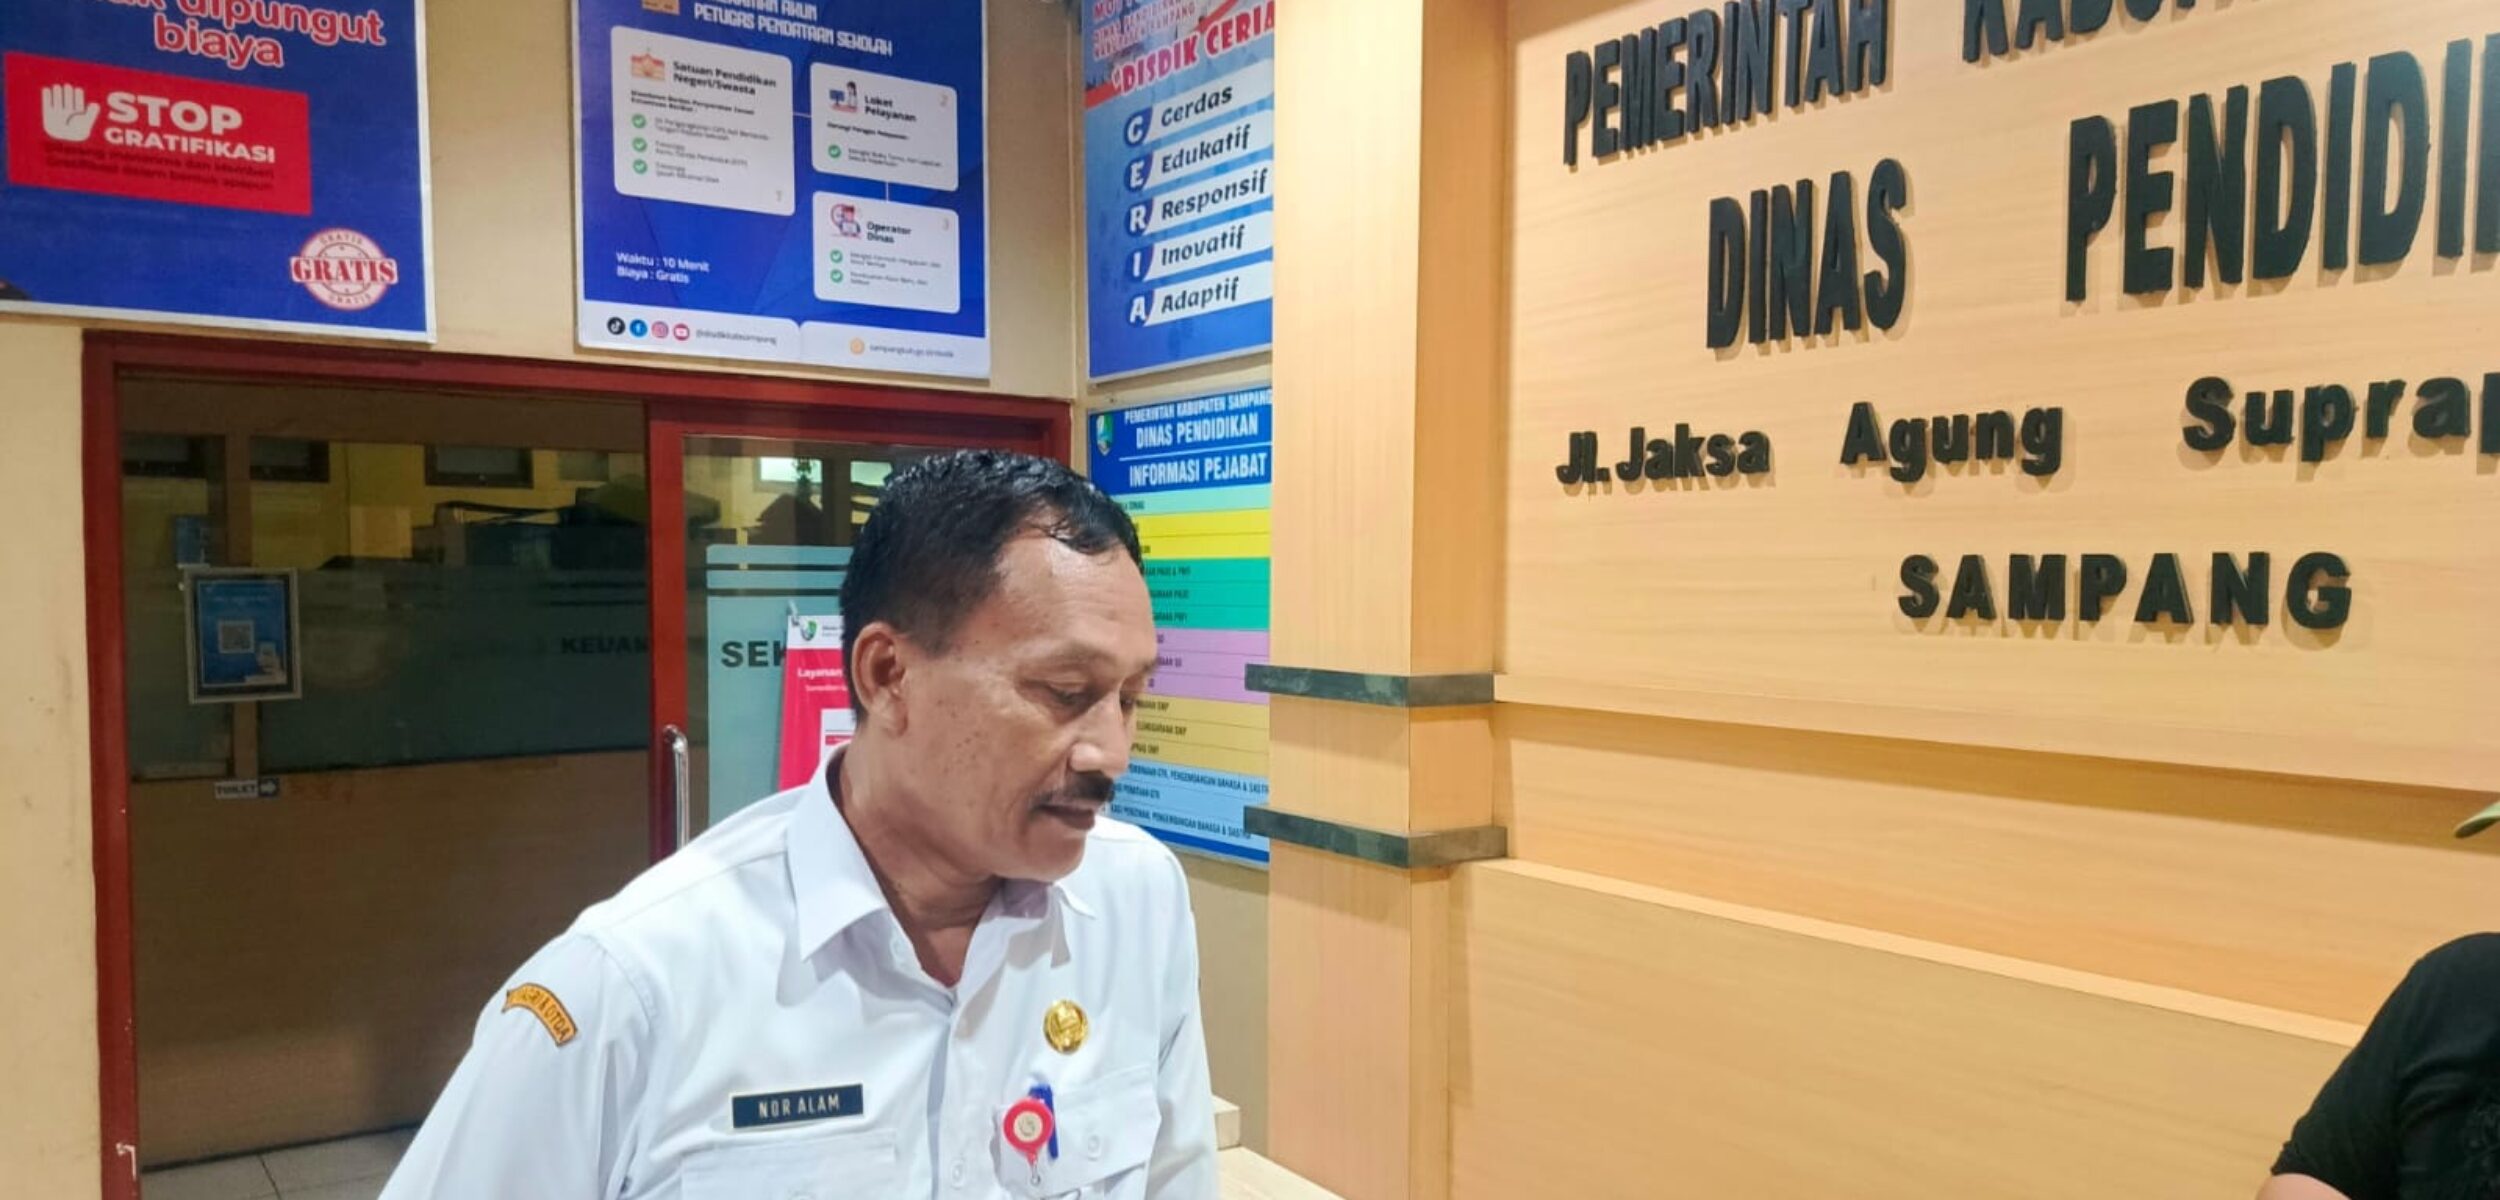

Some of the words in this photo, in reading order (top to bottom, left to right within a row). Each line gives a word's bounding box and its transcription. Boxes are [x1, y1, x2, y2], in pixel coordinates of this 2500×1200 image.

[154, 13, 284, 69] biaya
[694, 3, 754, 30] PETUGAS
[757, 15, 834, 45] PENDATAAN
[836, 30, 892, 56] SEKOLAH
[1206, 1, 1274, 57] CERIA
[673, 61, 713, 76] Satuan
[715, 67, 777, 88] Pendidikan
[673, 73, 756, 95] Negeri/Swasta
[1563, 0, 1887, 166] PEMERINTAH
[106, 91, 243, 135] STOP
[864, 95, 893, 108] Loket
[865, 105, 917, 121] Pelayanan
[1127, 115, 1143, 144] C
[1161, 87, 1233, 127] Cerdas
[104, 127, 275, 163] GRATIFIKASI
[1129, 160, 1145, 189] E
[1162, 124, 1251, 173] Edukatif
[1130, 206, 1147, 234] R
[1162, 168, 1268, 220] Responsif
[1707, 158, 1908, 349] DINAS
[2066, 33, 2500, 302] PENDIDI
[867, 221, 912, 235] Operator
[867, 232, 895, 244] Dinas
[1162, 225, 1245, 266] Inovatif
[293, 259, 395, 282] GRATIS
[616, 252, 654, 267] Waktu
[662, 256, 676, 268] 10
[678, 259, 710, 273] Menit
[617, 266, 649, 281] Biaya
[655, 271, 690, 284] Gratis
[1130, 297, 1147, 324] A
[1162, 277, 1239, 314] Adaptif
[1124, 403, 1175, 424] PEMERINTAH
[1177, 396, 1226, 417] KABUPATEN
[1136, 422, 1173, 449] DINAS
[1177, 412, 1258, 444] PENDIDIKAN
[1556, 431, 1609, 485] Jl.
[1616, 423, 1770, 481] Jaksa
[1840, 402, 2063, 483] Agung
[2183, 373, 2500, 463] Supra
[1130, 458, 1200, 487] INFORMASI
[1204, 452, 1267, 481] PEJABAT
[1898, 551, 2352, 630] SAMPANG
[798, 667, 843, 681] Layanan
[759, 1098, 791, 1119] NOR
[797, 1093, 840, 1114] ALAM
